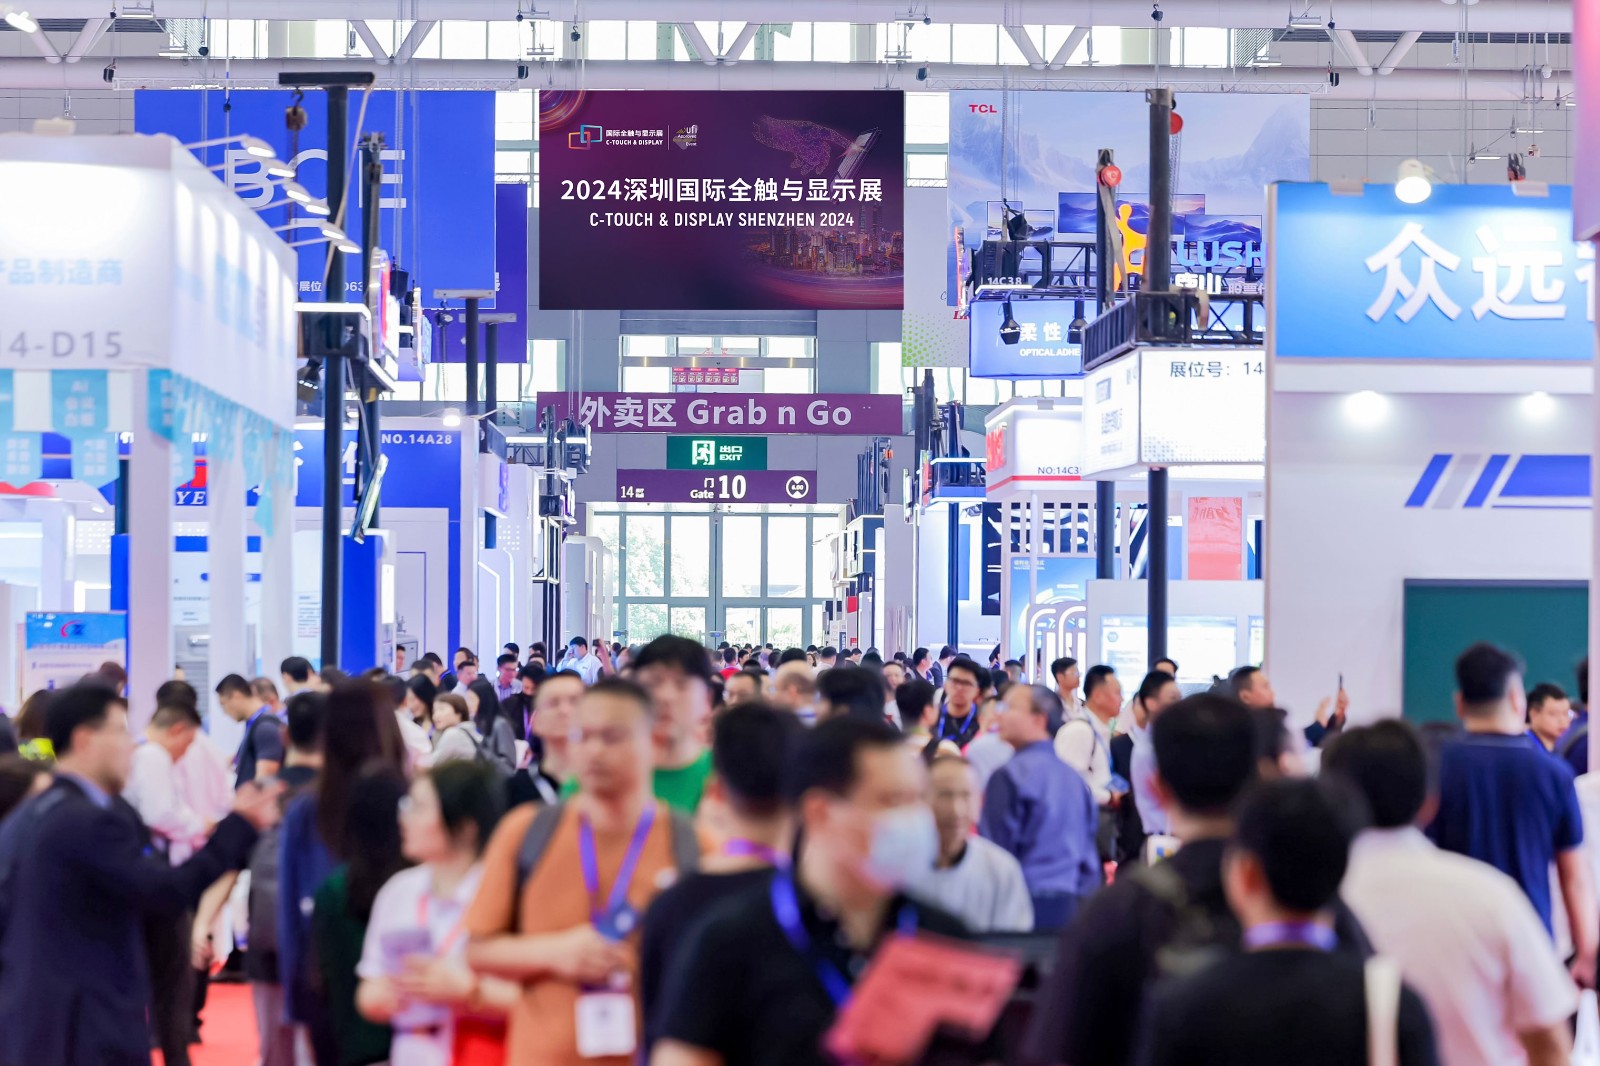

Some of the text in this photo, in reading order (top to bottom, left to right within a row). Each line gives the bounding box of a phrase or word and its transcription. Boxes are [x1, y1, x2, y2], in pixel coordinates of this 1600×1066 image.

[968, 104, 998, 114] TCL
[560, 177, 883, 203] 2024深圳国际全触与显示展
[589, 212, 854, 227] C-TOUCH & DISPLAY SHENZHEN 2024
[0, 257, 122, 285] 品制造商
[296, 281, 322, 292] 展位
[987, 276, 1022, 286] 14C38
[0, 331, 122, 359] 4-D15
[1019, 348, 1056, 357] OPTICAL
[580, 396, 852, 428] 外卖区 Grab n Go
[381, 433, 453, 445] NO.14A28
[719, 445, 743, 454] 出口
[1037, 466, 1081, 475] NO:14C3
[690, 474, 747, 499] Gate 10
[703, 477, 715, 489] 门
[620, 485, 634, 498] 14
